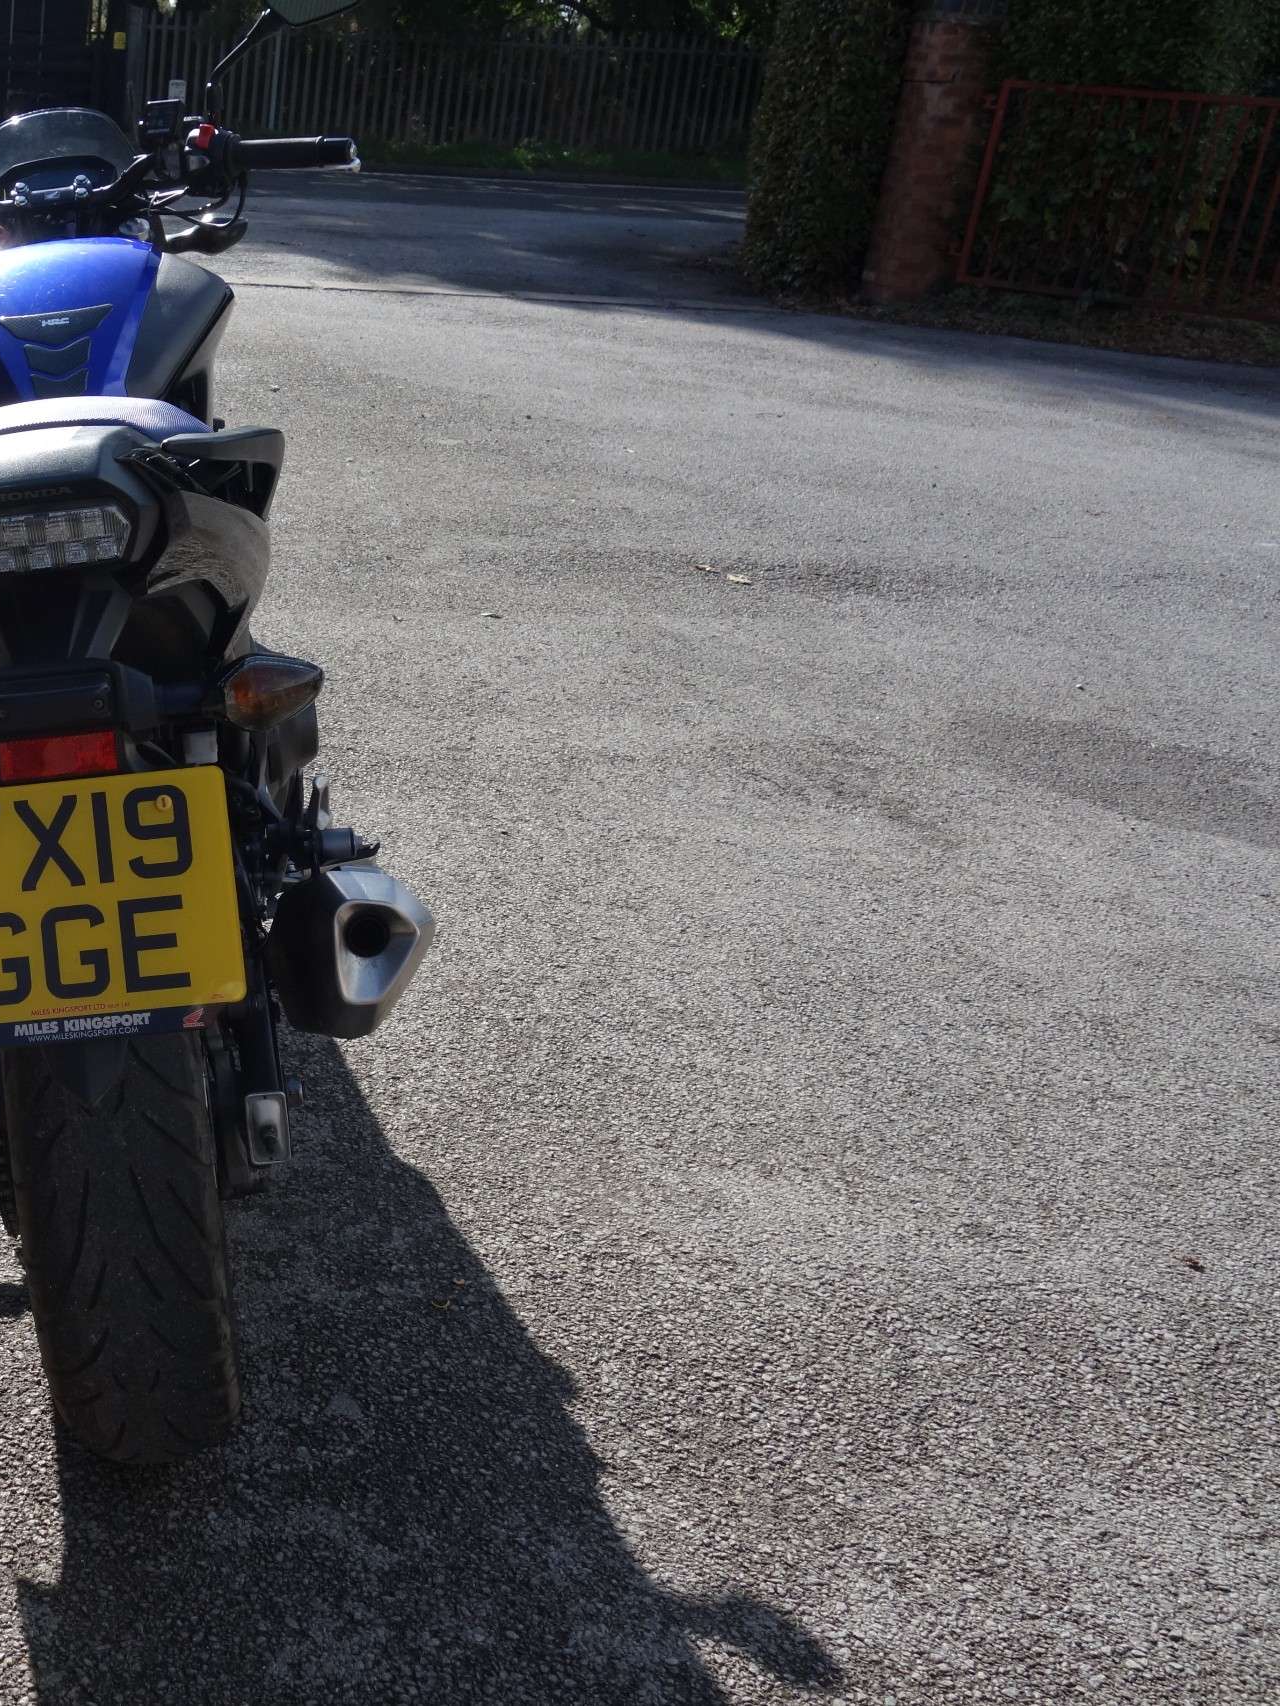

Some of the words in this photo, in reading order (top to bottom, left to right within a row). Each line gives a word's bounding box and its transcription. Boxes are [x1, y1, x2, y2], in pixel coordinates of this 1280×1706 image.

[14, 1021, 59, 1037] MILES
[63, 1012, 152, 1032] KINGSPORT
[28, 1026, 140, 1042] WWW.MILESKINGSPORT.COM
